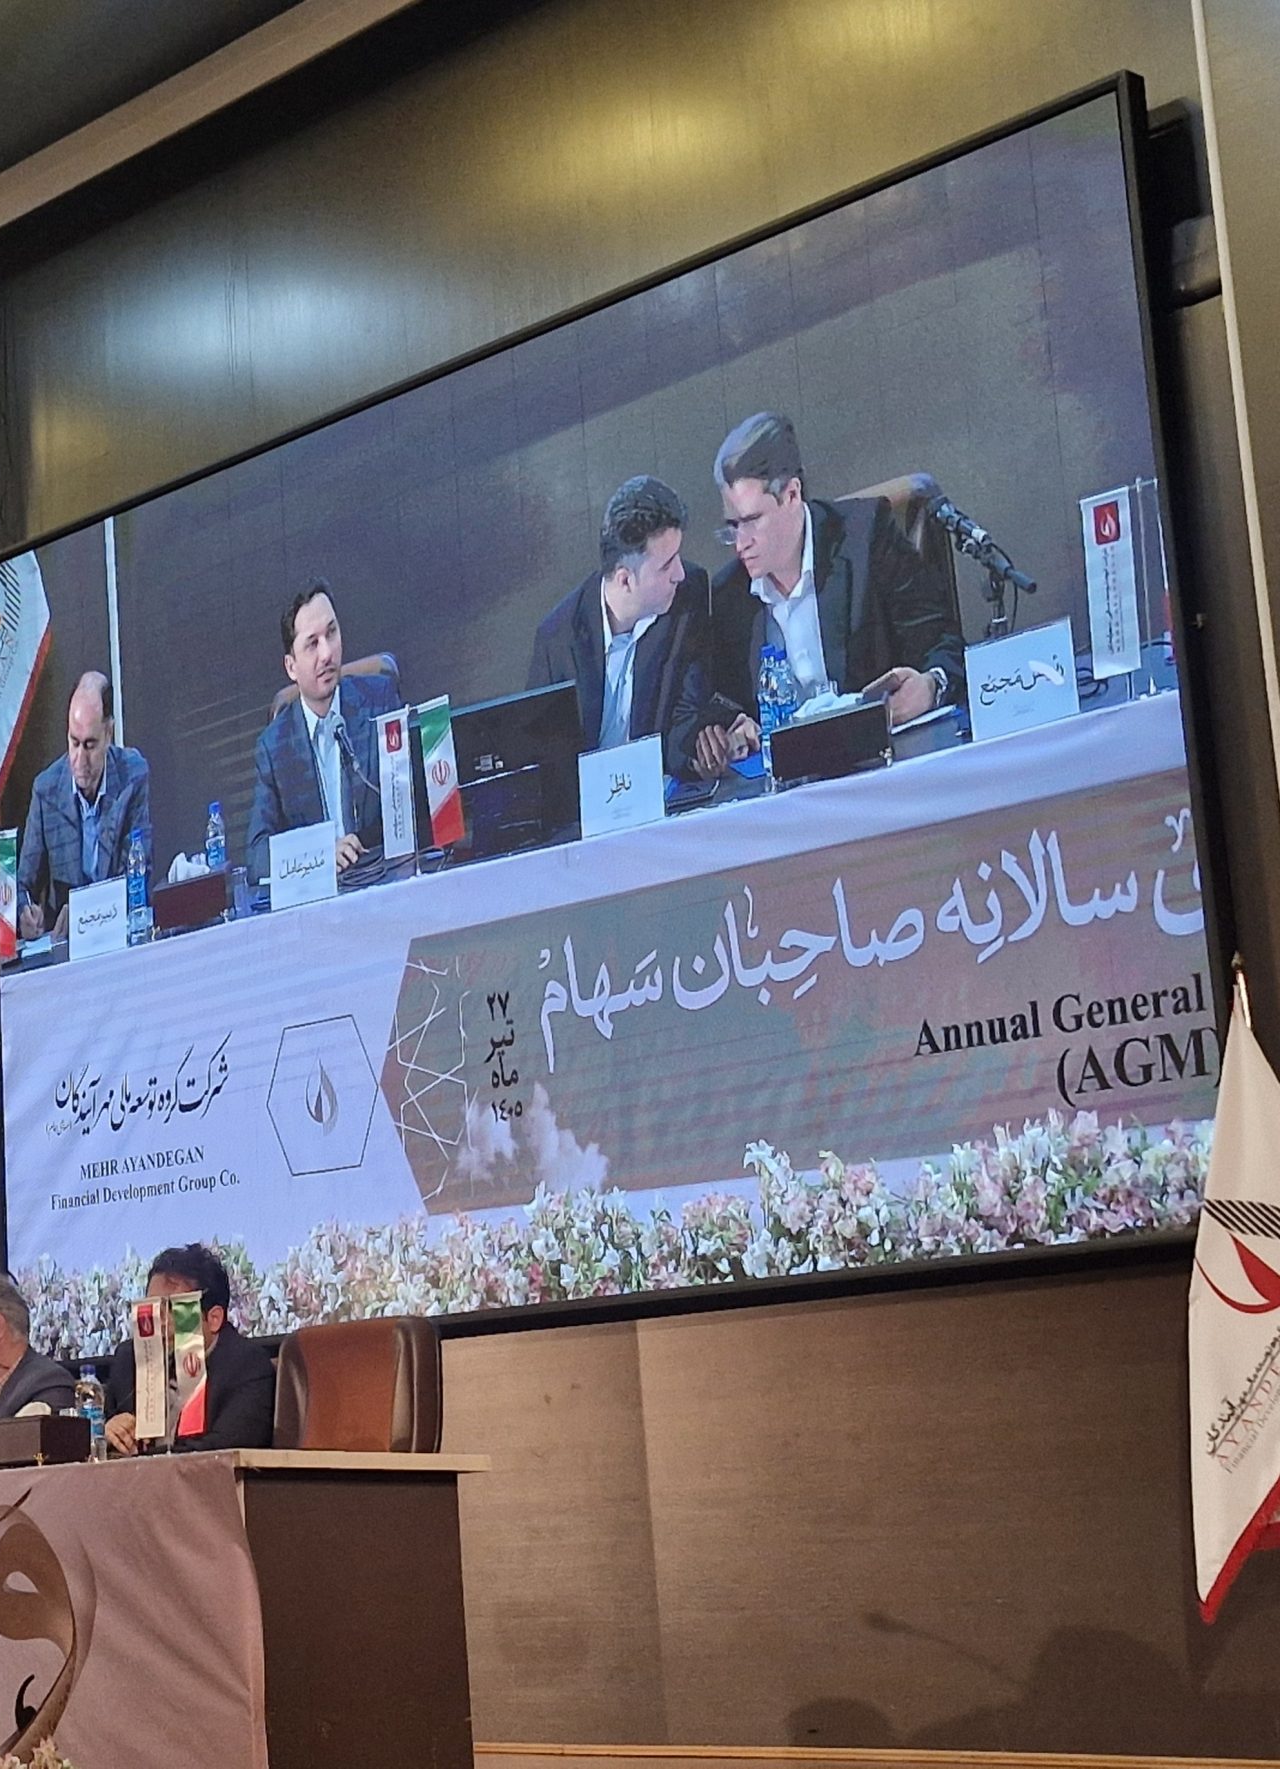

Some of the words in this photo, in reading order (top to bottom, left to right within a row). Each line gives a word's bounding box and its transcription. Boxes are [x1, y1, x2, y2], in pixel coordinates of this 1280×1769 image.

[913, 1000, 1043, 1057] Annual
[1052, 972, 1209, 1035] General
[490, 1056, 519, 1089] ماه
[80, 1158, 121, 1181] MEHR
[121, 1145, 206, 1175] AYANDEGAN
[51, 1189, 101, 1211] Financial
[103, 1180, 175, 1204] Development
[178, 1175, 217, 1194] Group
[219, 1169, 241, 1188] Co.
